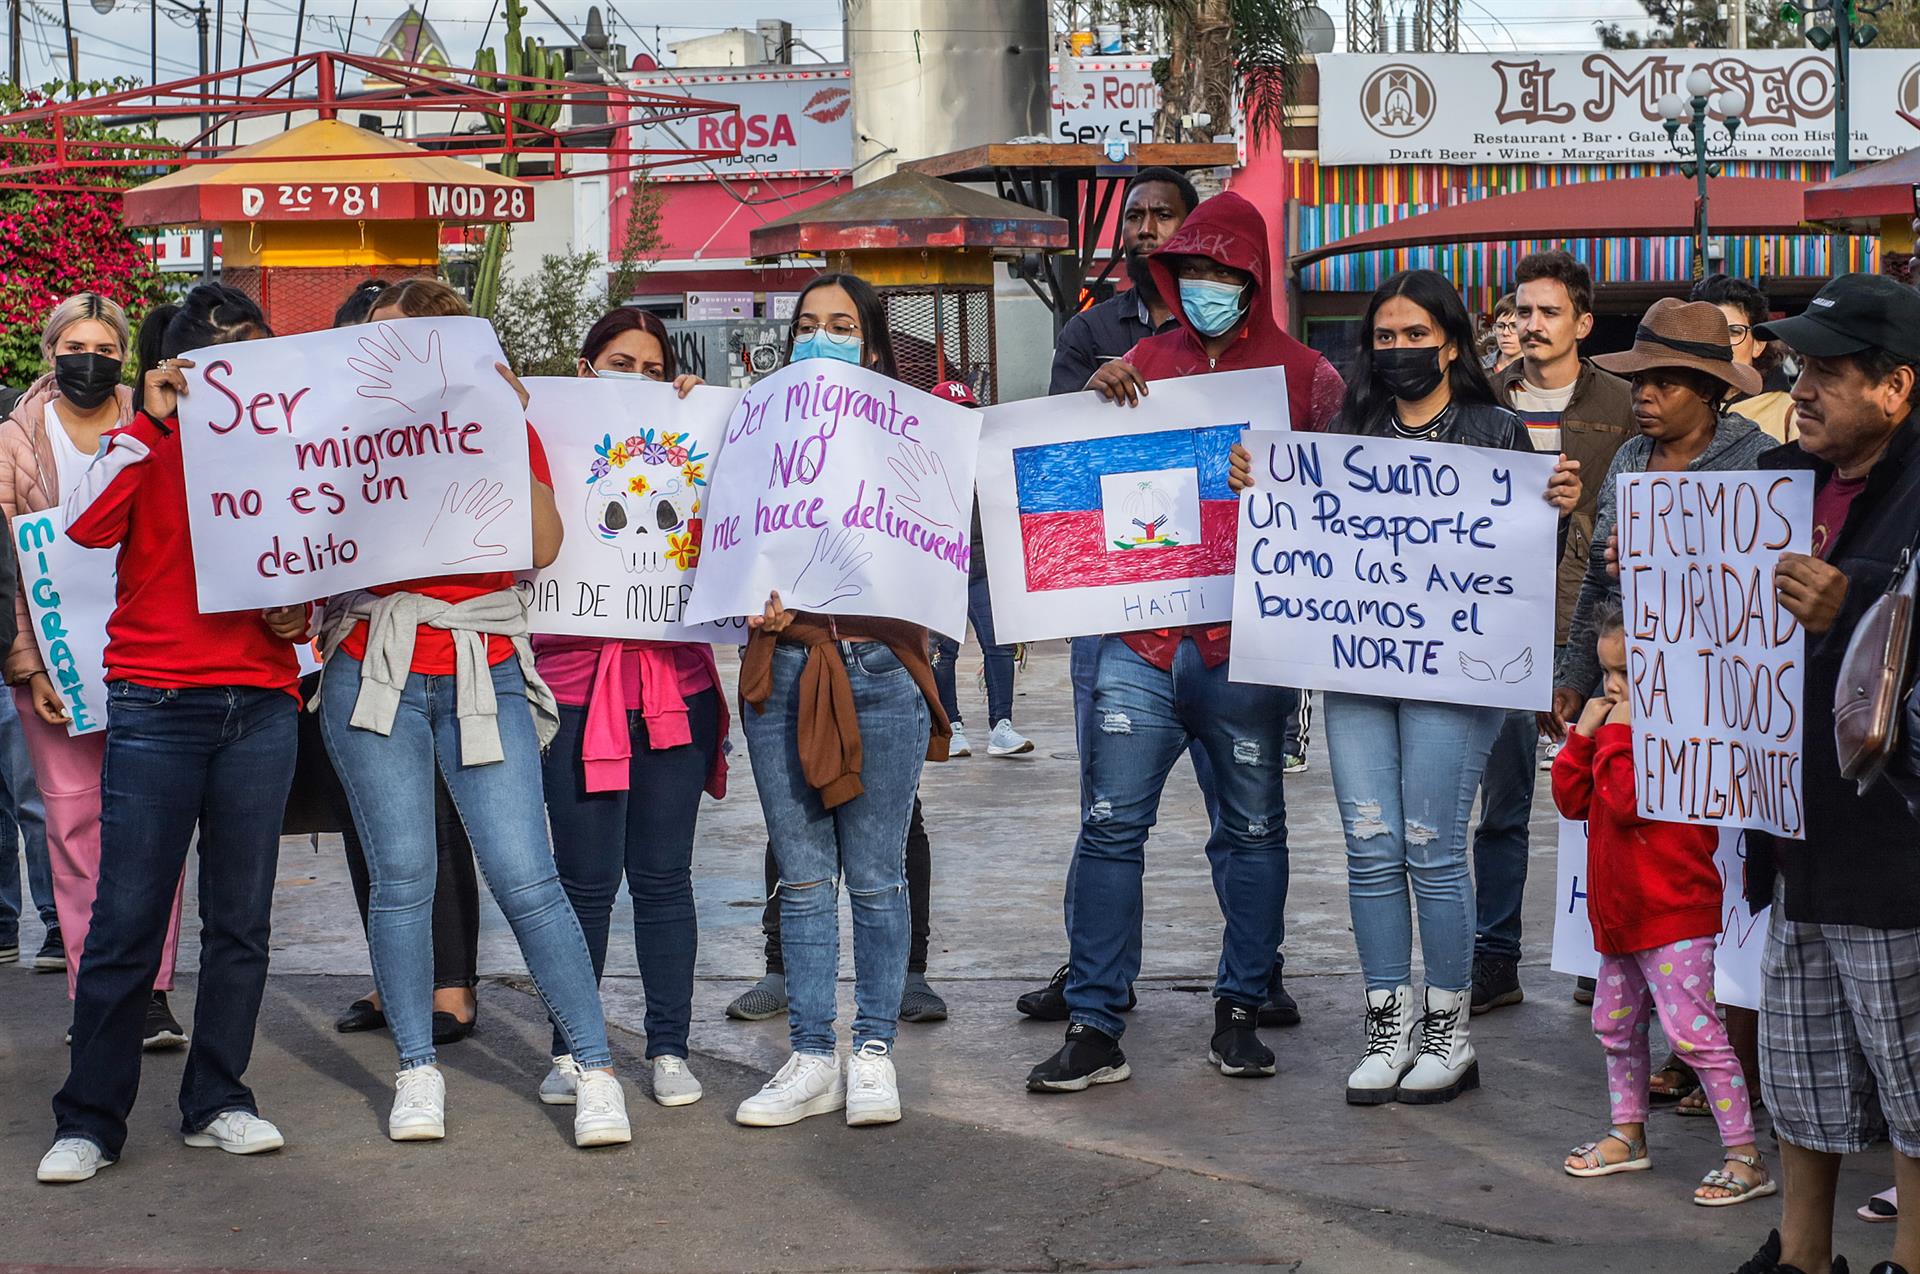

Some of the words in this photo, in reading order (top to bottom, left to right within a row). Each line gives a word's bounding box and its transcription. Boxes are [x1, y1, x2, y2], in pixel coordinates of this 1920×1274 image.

[1490, 59, 1576, 125] EL
[697, 113, 797, 149] ROSA
[1389, 148, 1434, 160] Draft
[1439, 149, 1477, 160] Beer
[1499, 148, 1541, 159] Wine
[1562, 147, 1655, 161] Margaritas
[1769, 146, 1836, 158] Mezcale
[1473, 132, 1566, 144] Restaurant
[1583, 131, 1612, 144] Bar
[1628, 131, 1689, 142] Galeia
[1771, 132, 1799, 142] con
[1804, 130, 1869, 141] Histria
[242, 187, 265, 217] D
[427, 186, 486, 217] MOD
[493, 188, 527, 218] 28
[203, 359, 311, 435] Ser
[729, 389, 774, 443] Ser
[785, 374, 921, 443] migrante
[295, 410, 485, 483] migrante
[768, 434, 827, 489] NO
[211, 488, 263, 519] no
[287, 482, 346, 515] es
[361, 475, 409, 505] un
[712, 515, 742, 552] me
[755, 496, 828, 536] hace
[1247, 492, 1298, 531] Un
[1311, 489, 1496, 556] Pasaporte
[256, 532, 359, 579] delito
[1251, 536, 1334, 579] Como
[1354, 548, 1408, 585] las
[1426, 563, 1514, 595] Aves
[18, 517, 98, 732] MIGRANTE
[571, 581, 611, 617] DE
[1254, 580, 1426, 629] buscamos
[1451, 602, 1484, 636] el
[1332, 633, 1444, 674] NORTE
[1696, 648, 1797, 743] TODOS
